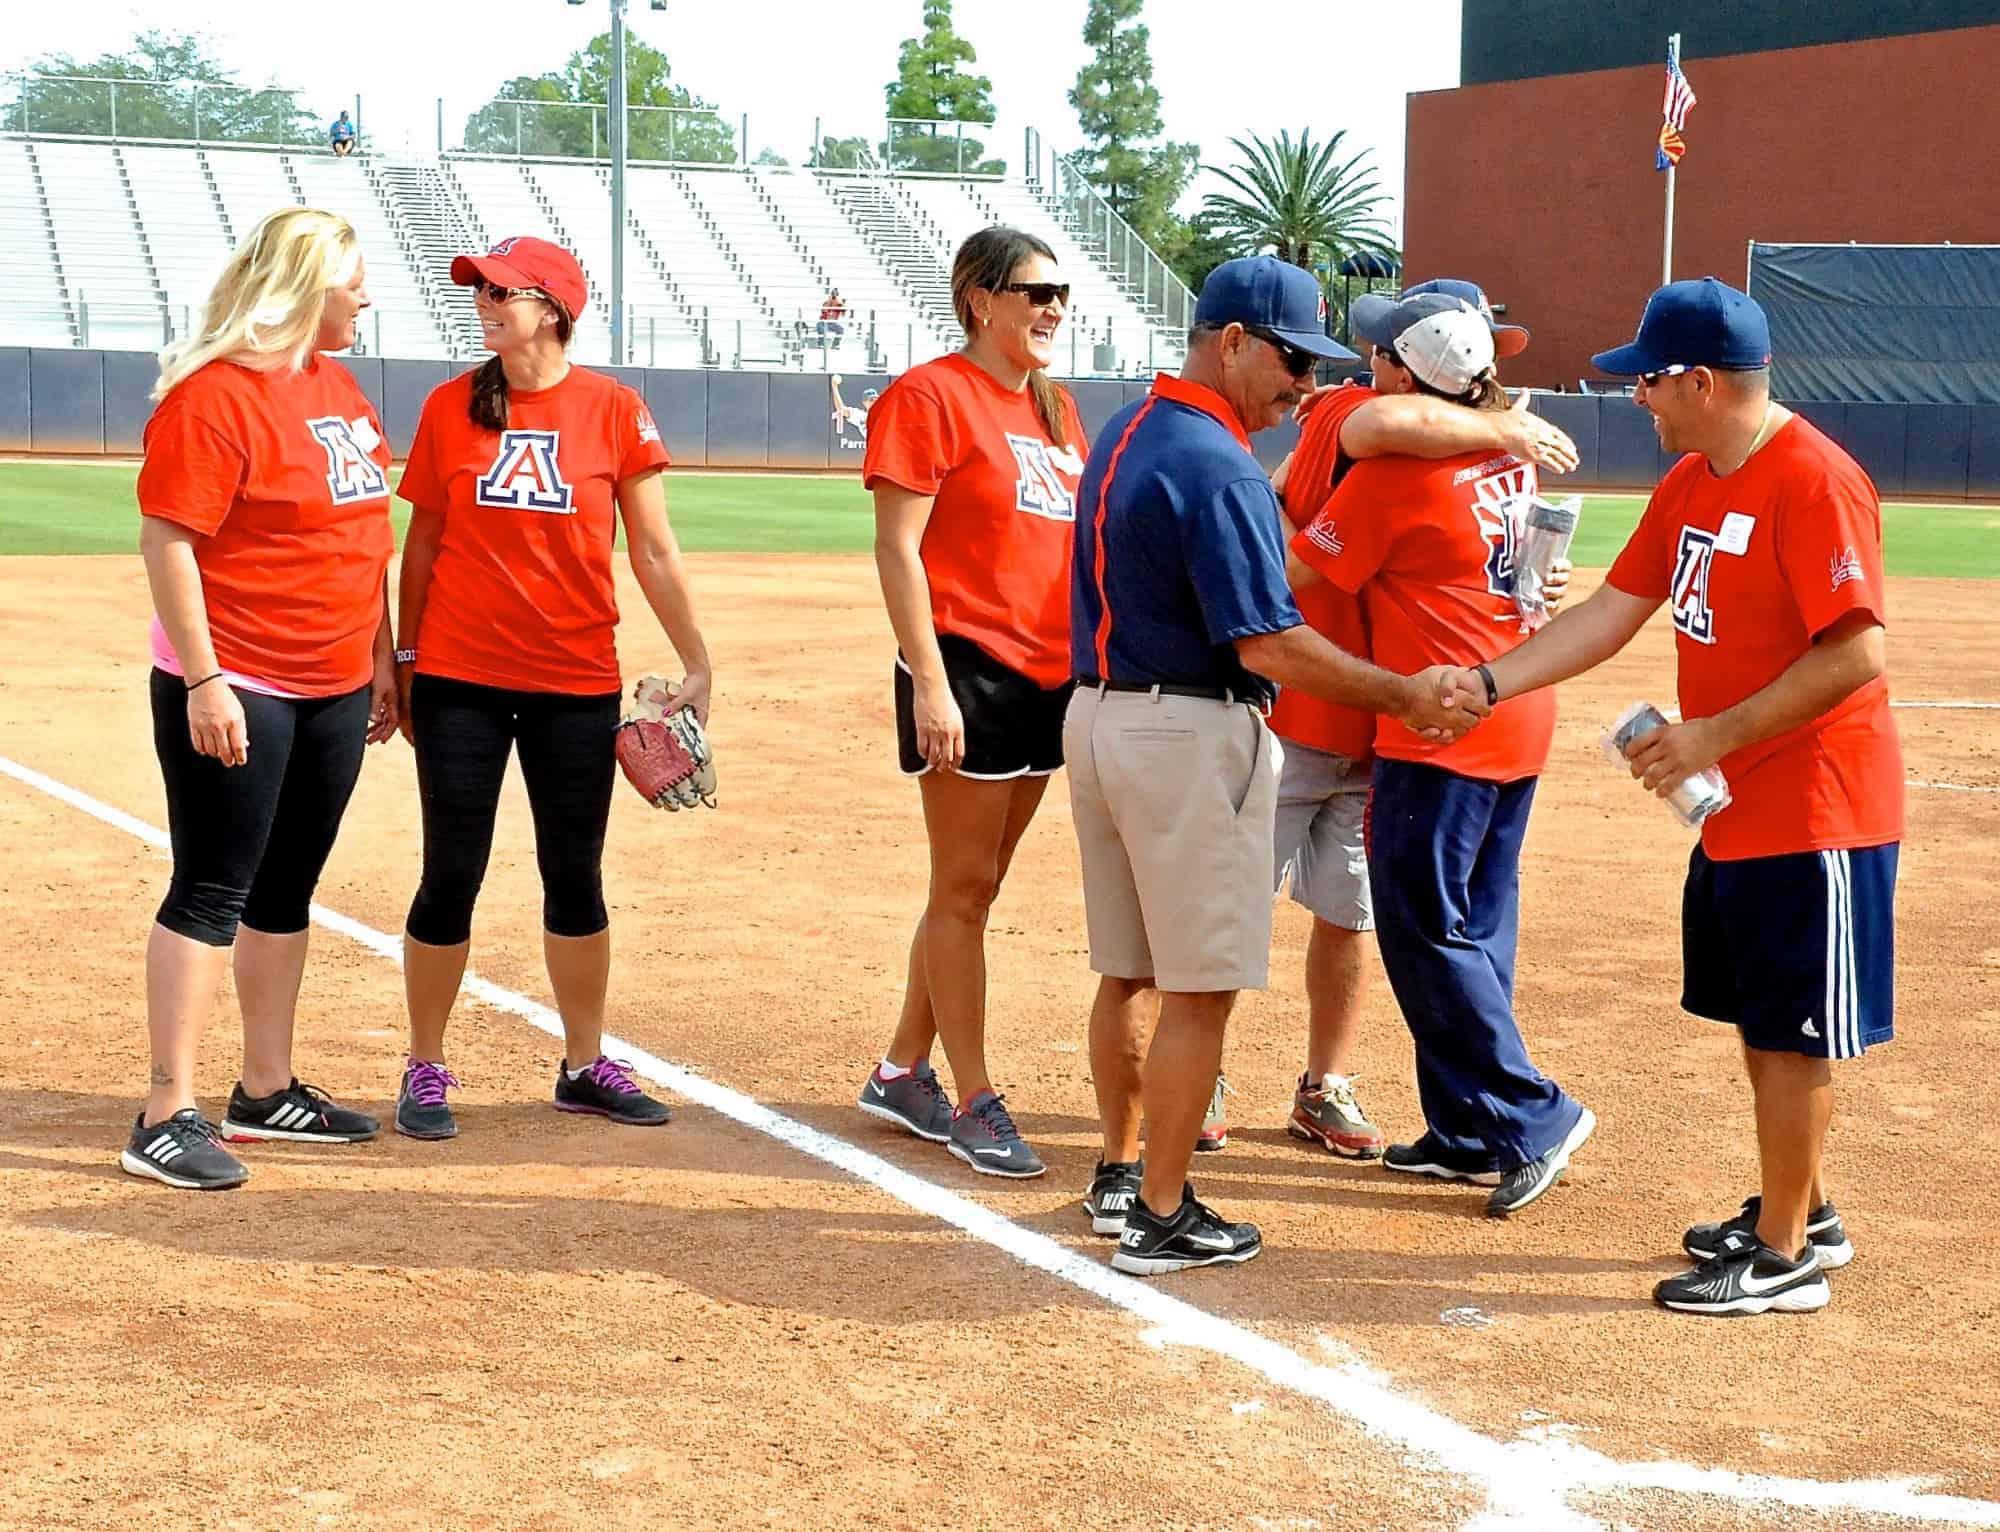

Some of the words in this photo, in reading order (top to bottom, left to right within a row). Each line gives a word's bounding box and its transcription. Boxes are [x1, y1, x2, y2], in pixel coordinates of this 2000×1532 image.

[304, 415, 391, 506] A
[476, 430, 573, 514] A
[840, 437, 867, 449] Parr
[1004, 431, 1076, 522] A
[1671, 524, 1714, 644] A
